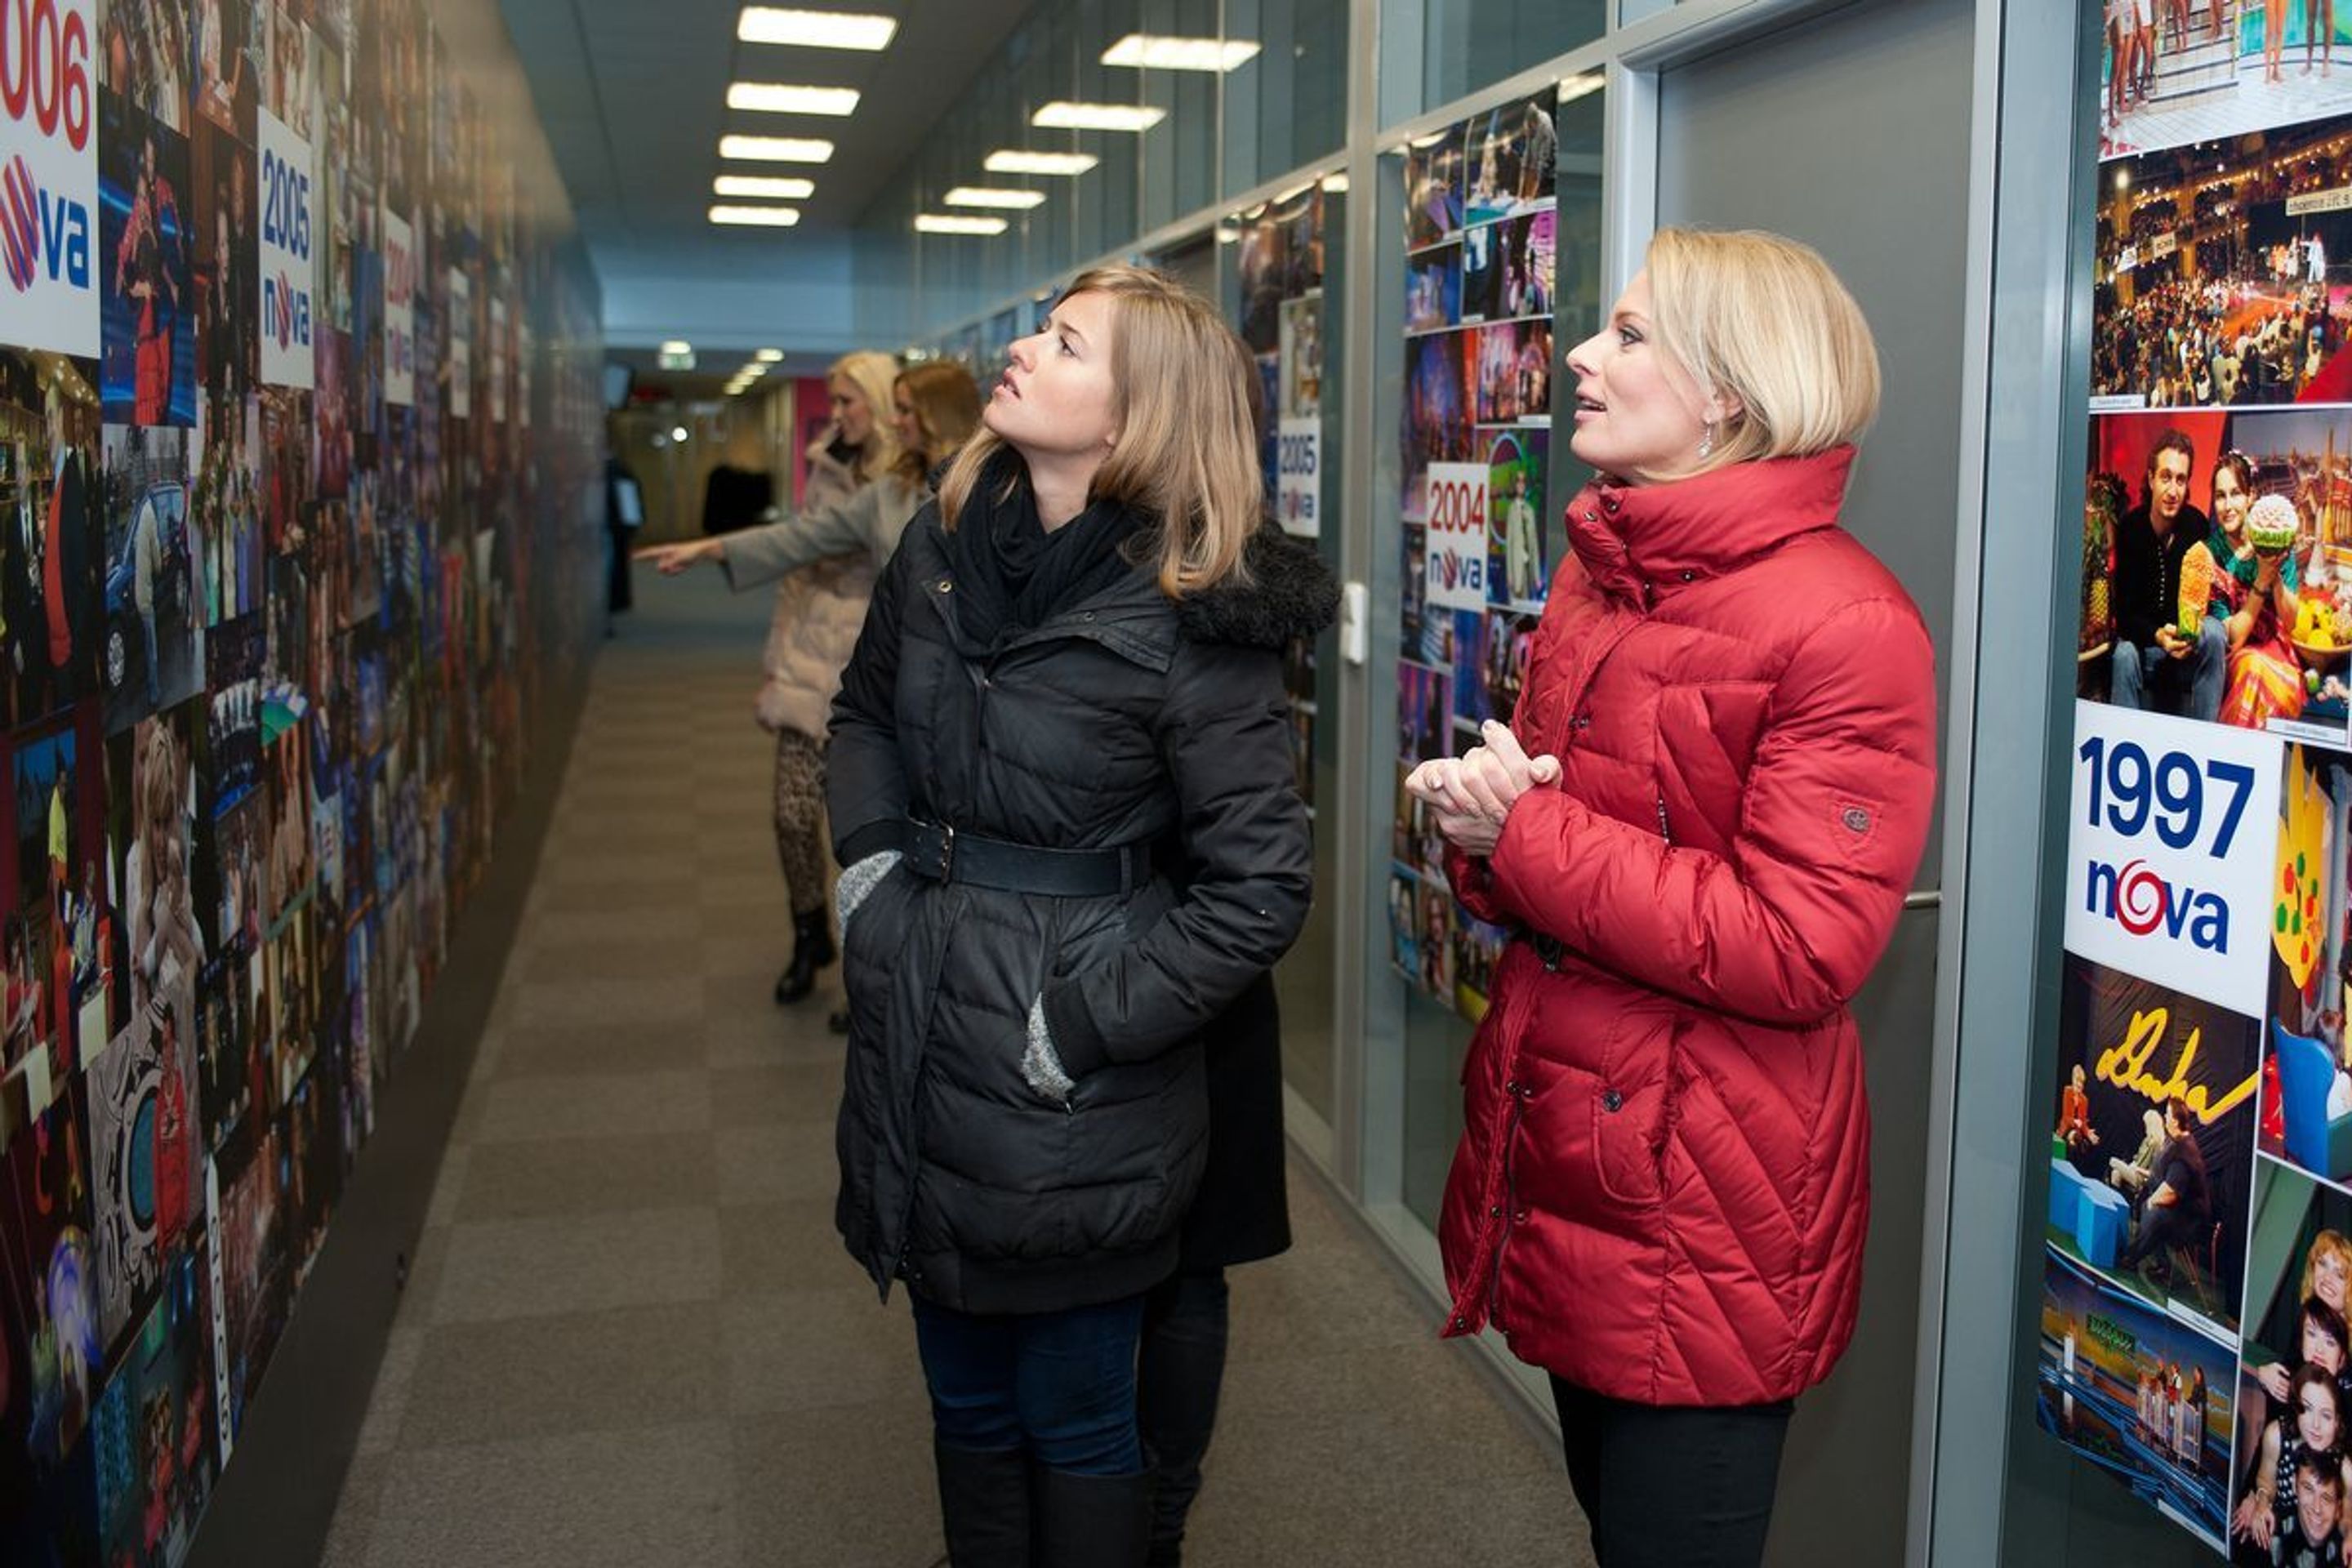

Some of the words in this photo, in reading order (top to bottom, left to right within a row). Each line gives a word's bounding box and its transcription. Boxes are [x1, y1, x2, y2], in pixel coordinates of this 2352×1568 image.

[263, 149, 309, 261] 2005
[265, 270, 310, 352] nova
[1281, 434, 1316, 474] 2005
[1431, 480, 1485, 535] 2004
[1430, 548, 1482, 590] nova
[2079, 736, 2255, 859] 1997
[2087, 859, 2230, 955] nova
